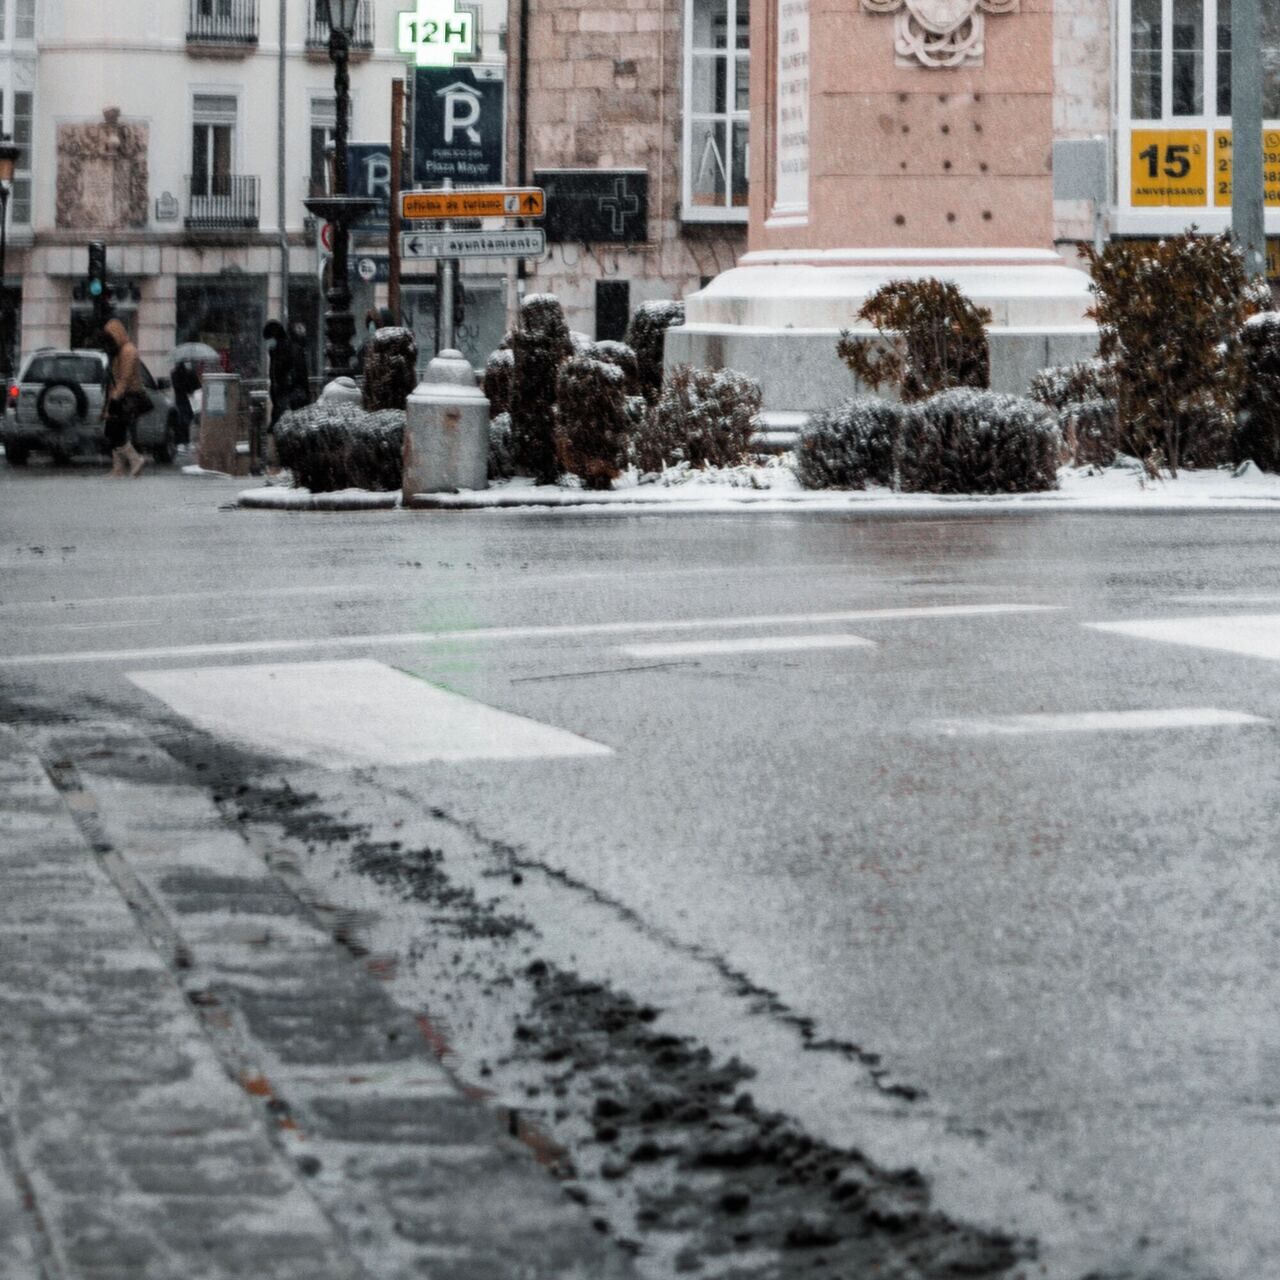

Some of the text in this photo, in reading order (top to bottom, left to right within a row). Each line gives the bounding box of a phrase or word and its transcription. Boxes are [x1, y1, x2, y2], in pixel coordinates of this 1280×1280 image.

[425, 159, 491, 176] Plaza Mayor
[1135, 185, 1205, 197] ANIVERSARIO
[406, 198, 441, 212] oficina
[446, 199, 458, 210] de
[463, 197, 502, 210] turismo
[449, 237, 540, 253] ayuntamiento
